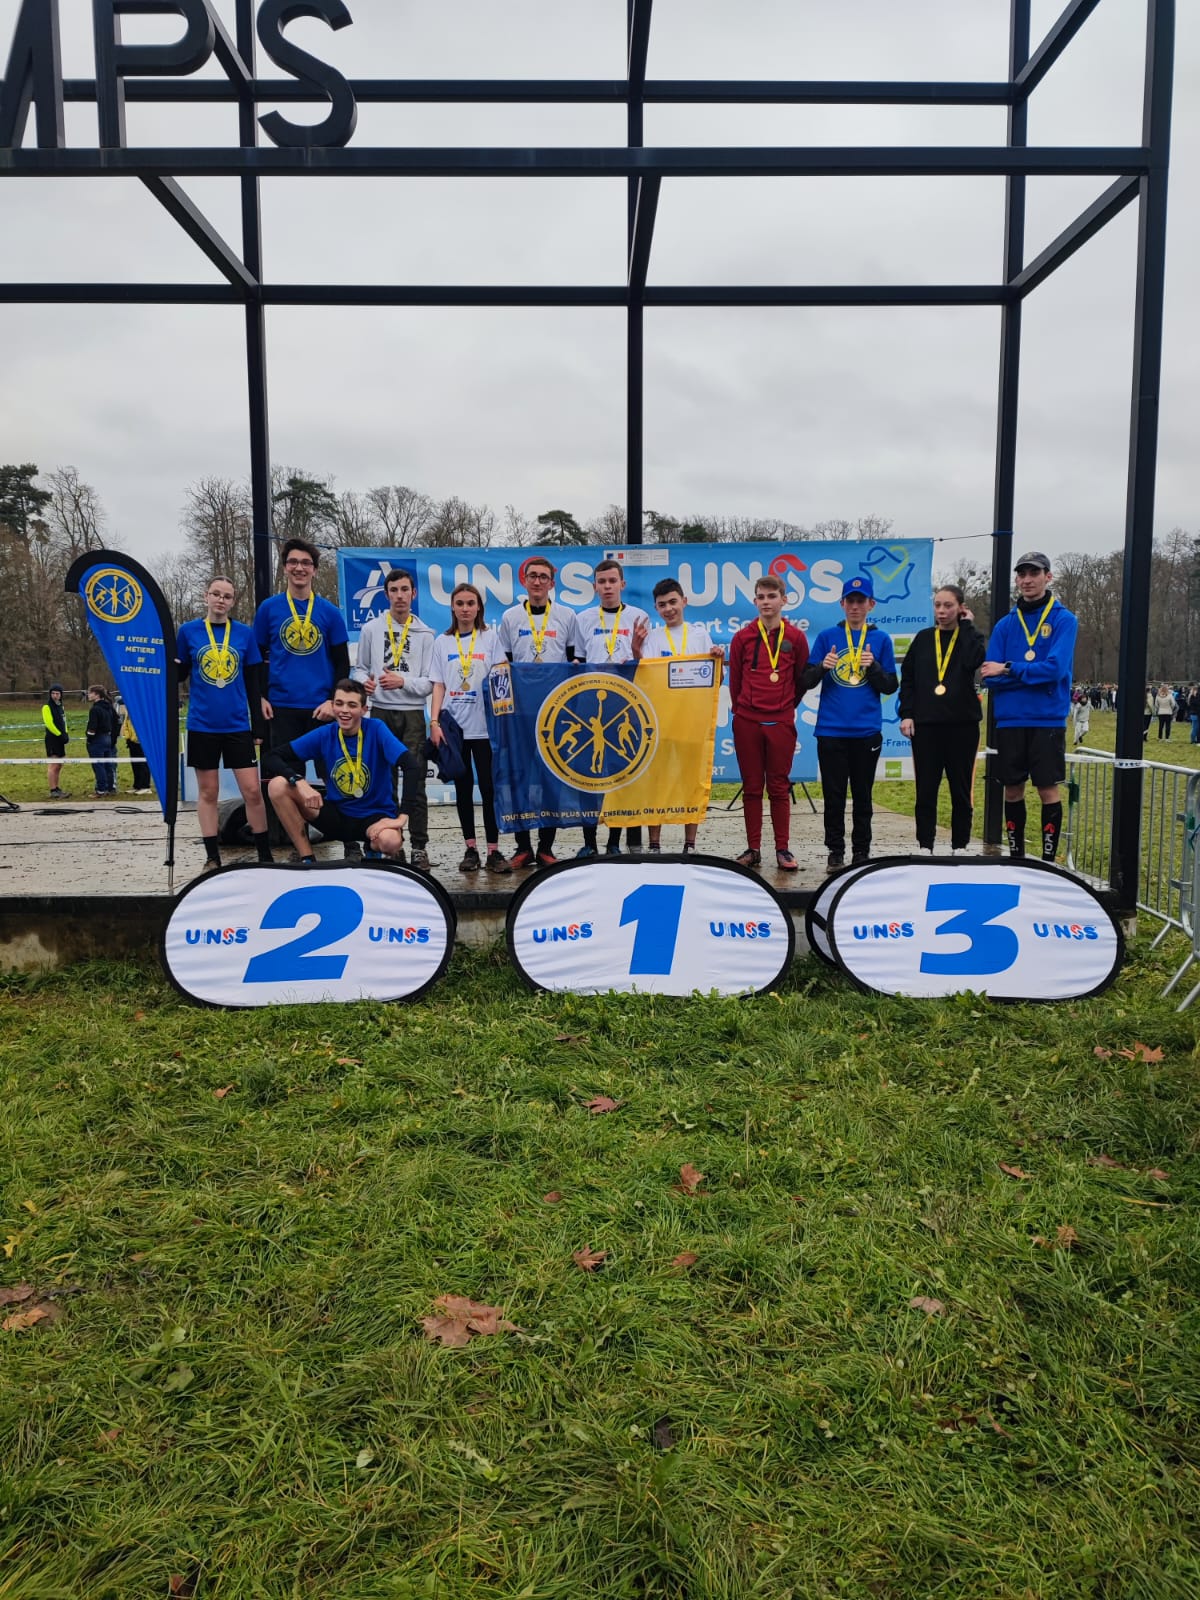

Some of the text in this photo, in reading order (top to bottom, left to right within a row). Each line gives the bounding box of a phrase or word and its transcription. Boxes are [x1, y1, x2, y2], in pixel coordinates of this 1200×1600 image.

[185, 885, 430, 983] UNSS 2 UNSS
[532, 884, 771, 975] UNSS 1 UNSS
[853, 883, 1099, 976] UNSS 3 UNSS
